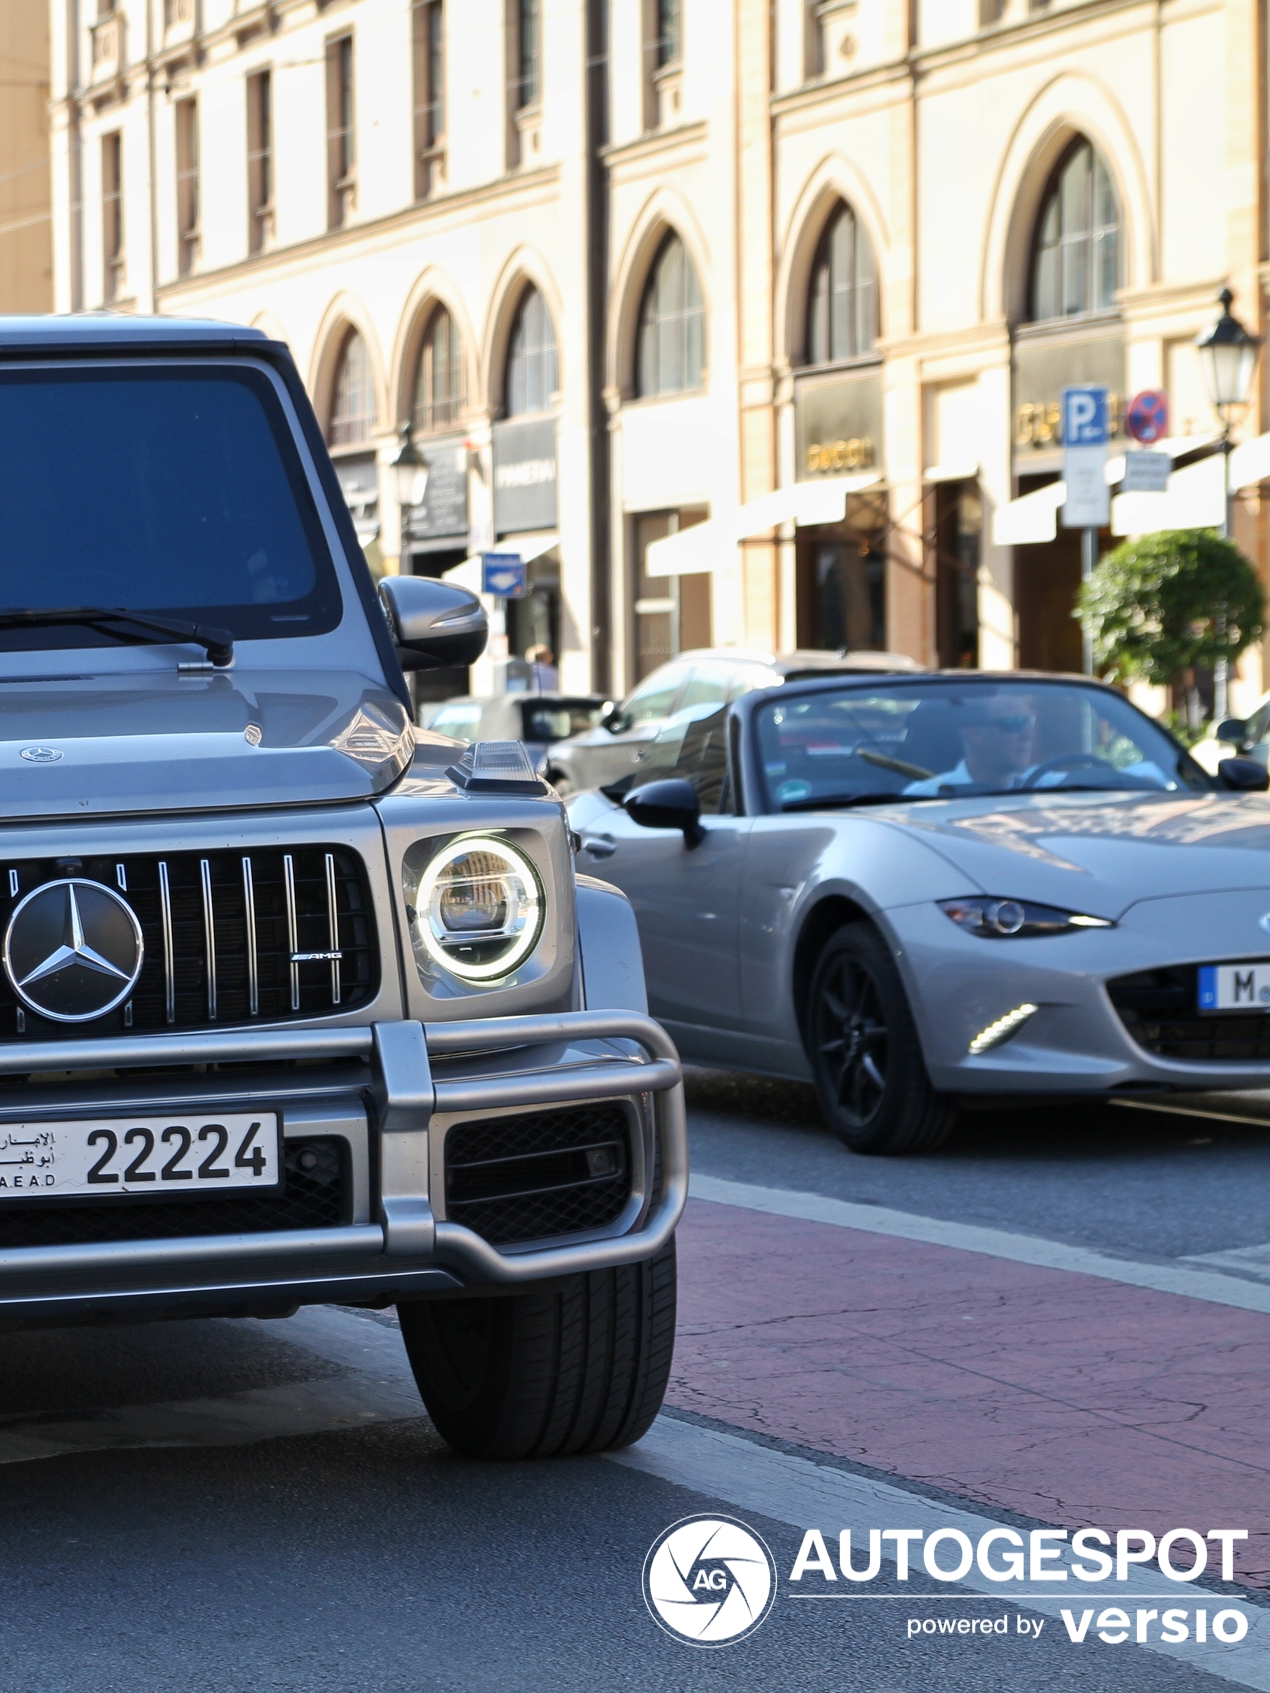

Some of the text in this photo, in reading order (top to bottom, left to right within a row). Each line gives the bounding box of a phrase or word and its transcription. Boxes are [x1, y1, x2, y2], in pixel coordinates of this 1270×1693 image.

[1069, 395, 1097, 442] P
[1234, 971, 1255, 1003] M
[87, 1121, 267, 1184] 22224
